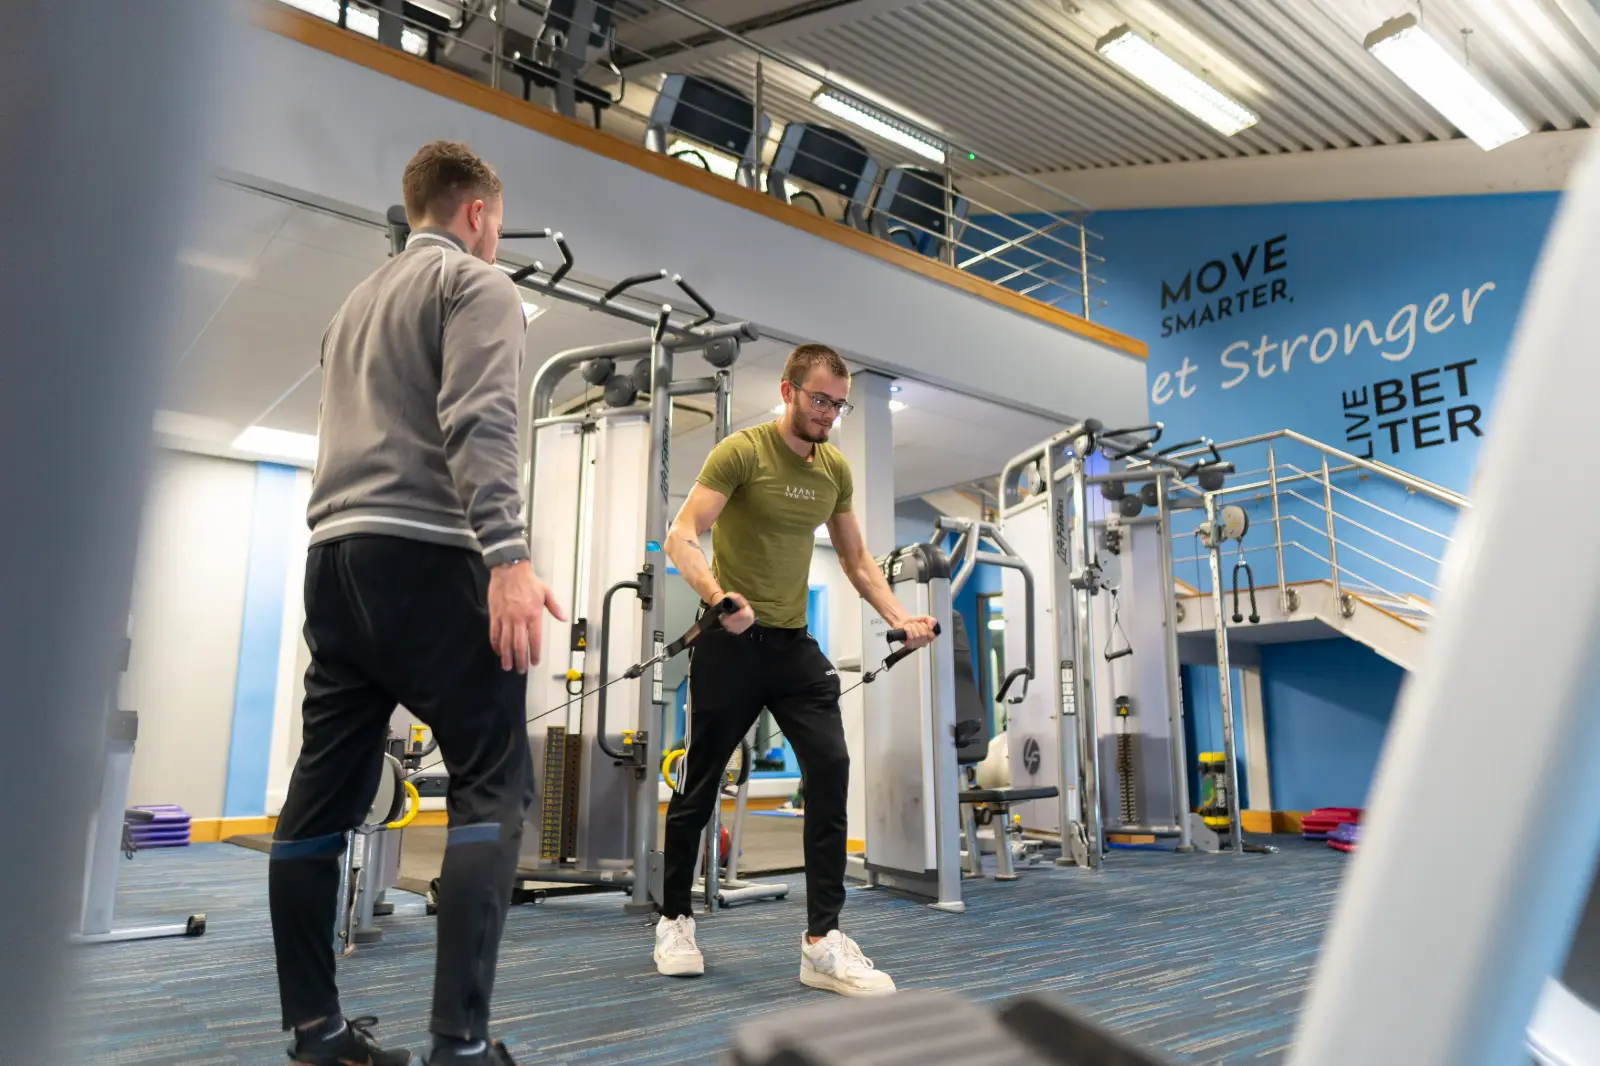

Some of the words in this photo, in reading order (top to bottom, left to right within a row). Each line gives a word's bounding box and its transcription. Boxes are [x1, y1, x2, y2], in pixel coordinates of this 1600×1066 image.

[1161, 233, 1287, 310] MOVE
[1160, 277, 1294, 337] SMARTER.
[1151, 356, 1198, 404] et
[1220, 281, 1496, 389] Stronger
[1373, 358, 1478, 416] BET
[1342, 385, 1373, 459] LIVE
[1378, 404, 1484, 454] TER
